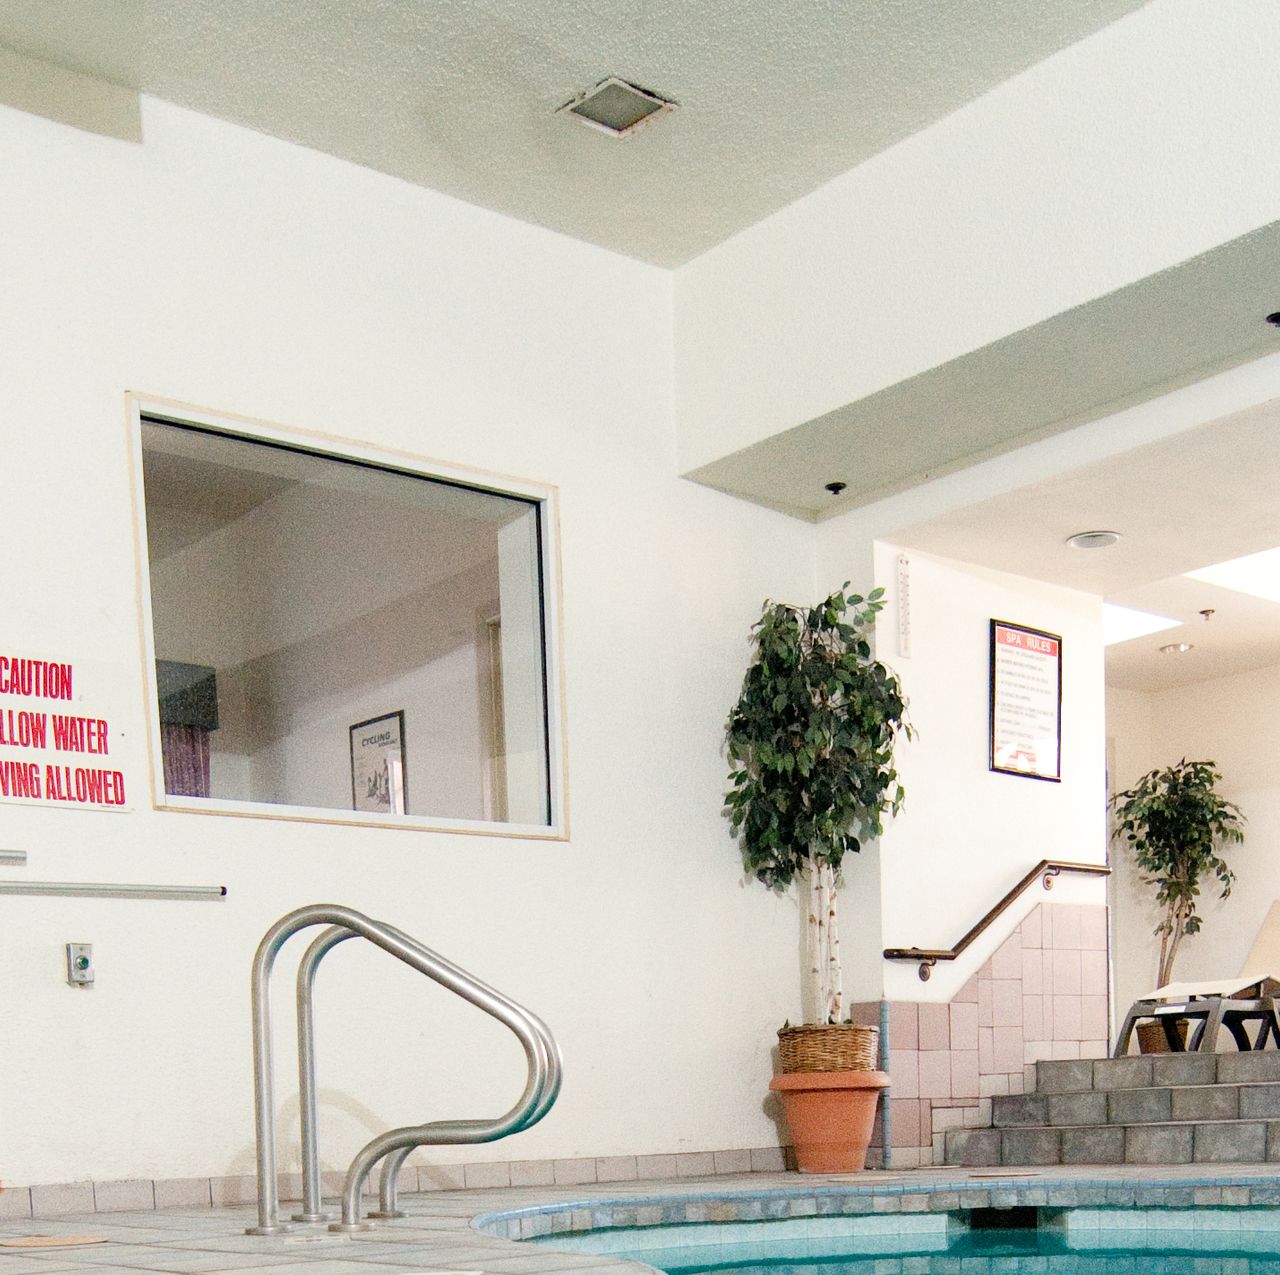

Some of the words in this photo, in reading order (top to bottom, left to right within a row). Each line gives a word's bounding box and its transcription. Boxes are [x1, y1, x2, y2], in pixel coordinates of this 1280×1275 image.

[1006, 632, 1021, 646] SPA
[1026, 636, 1051, 654] RULES
[52, 714, 109, 755] WATER
[361, 731, 391, 747] CYCLING
[46, 765, 126, 805] ALLOWED
